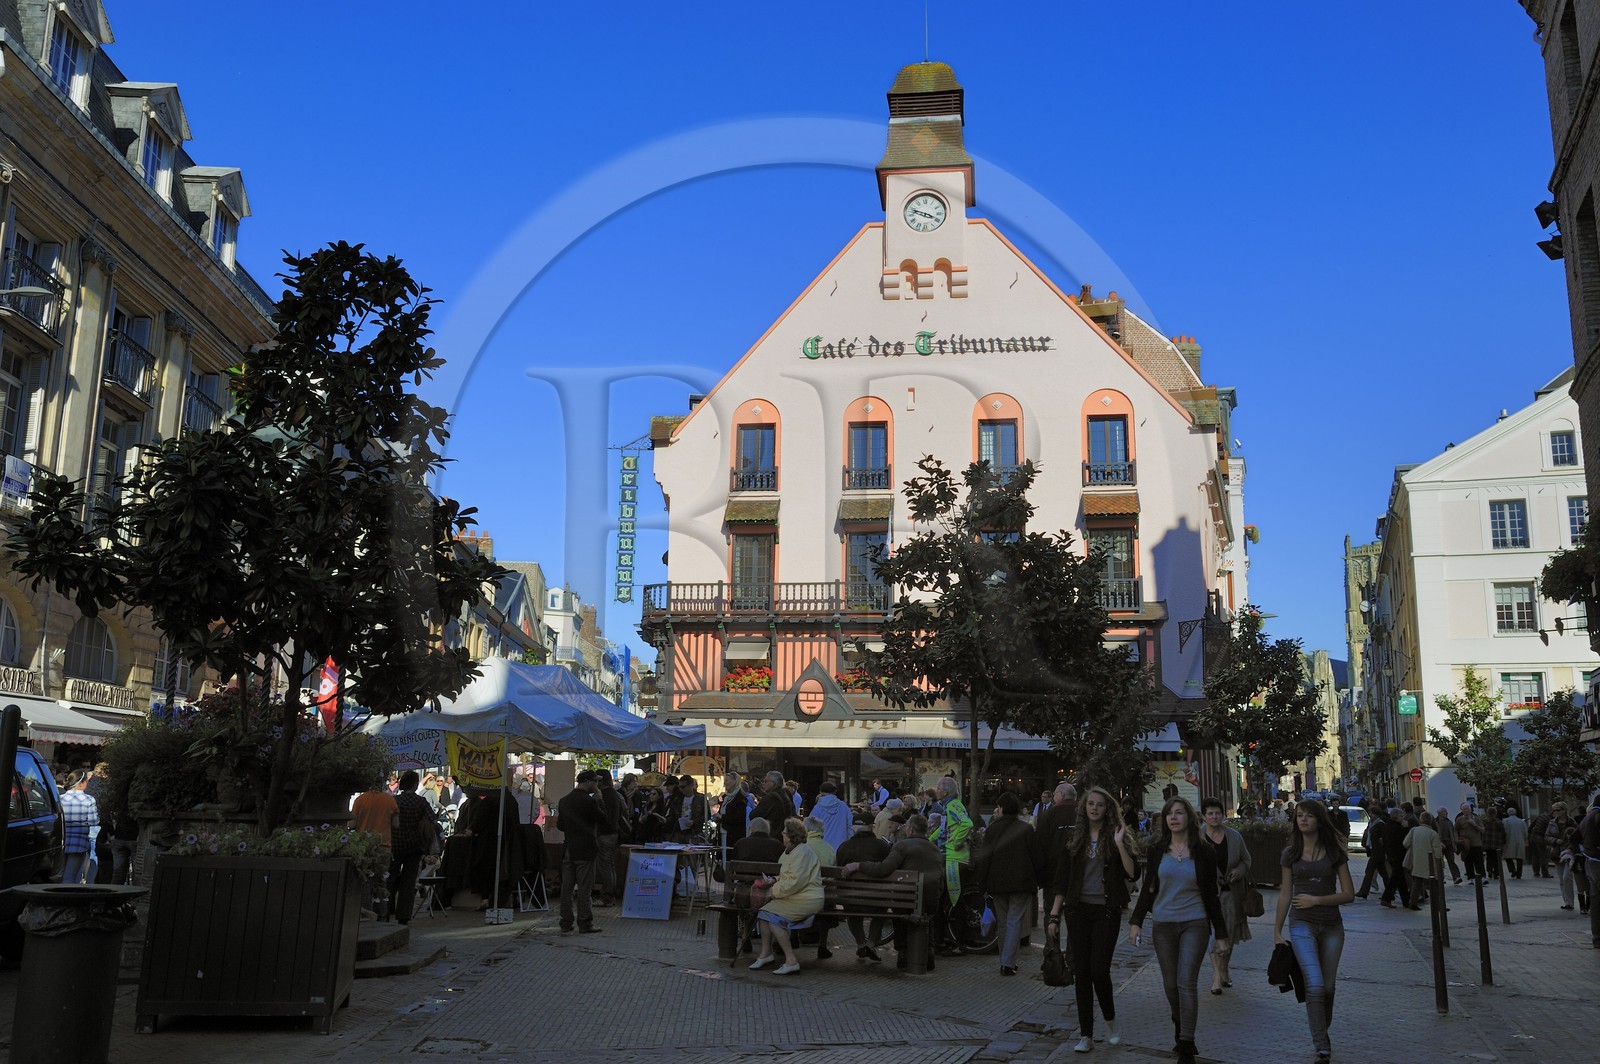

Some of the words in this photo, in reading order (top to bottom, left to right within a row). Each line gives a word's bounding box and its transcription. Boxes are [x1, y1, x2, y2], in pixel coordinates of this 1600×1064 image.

[803, 334, 858, 360] Café
[868, 335, 905, 359] des
[915, 330, 1051, 356] Tribunaux
[618, 457, 637, 599] Tribunaux
[70, 679, 136, 709] CHOCOLATIER
[868, 739, 892, 748] Café
[921, 740, 969, 748] Tribunau
